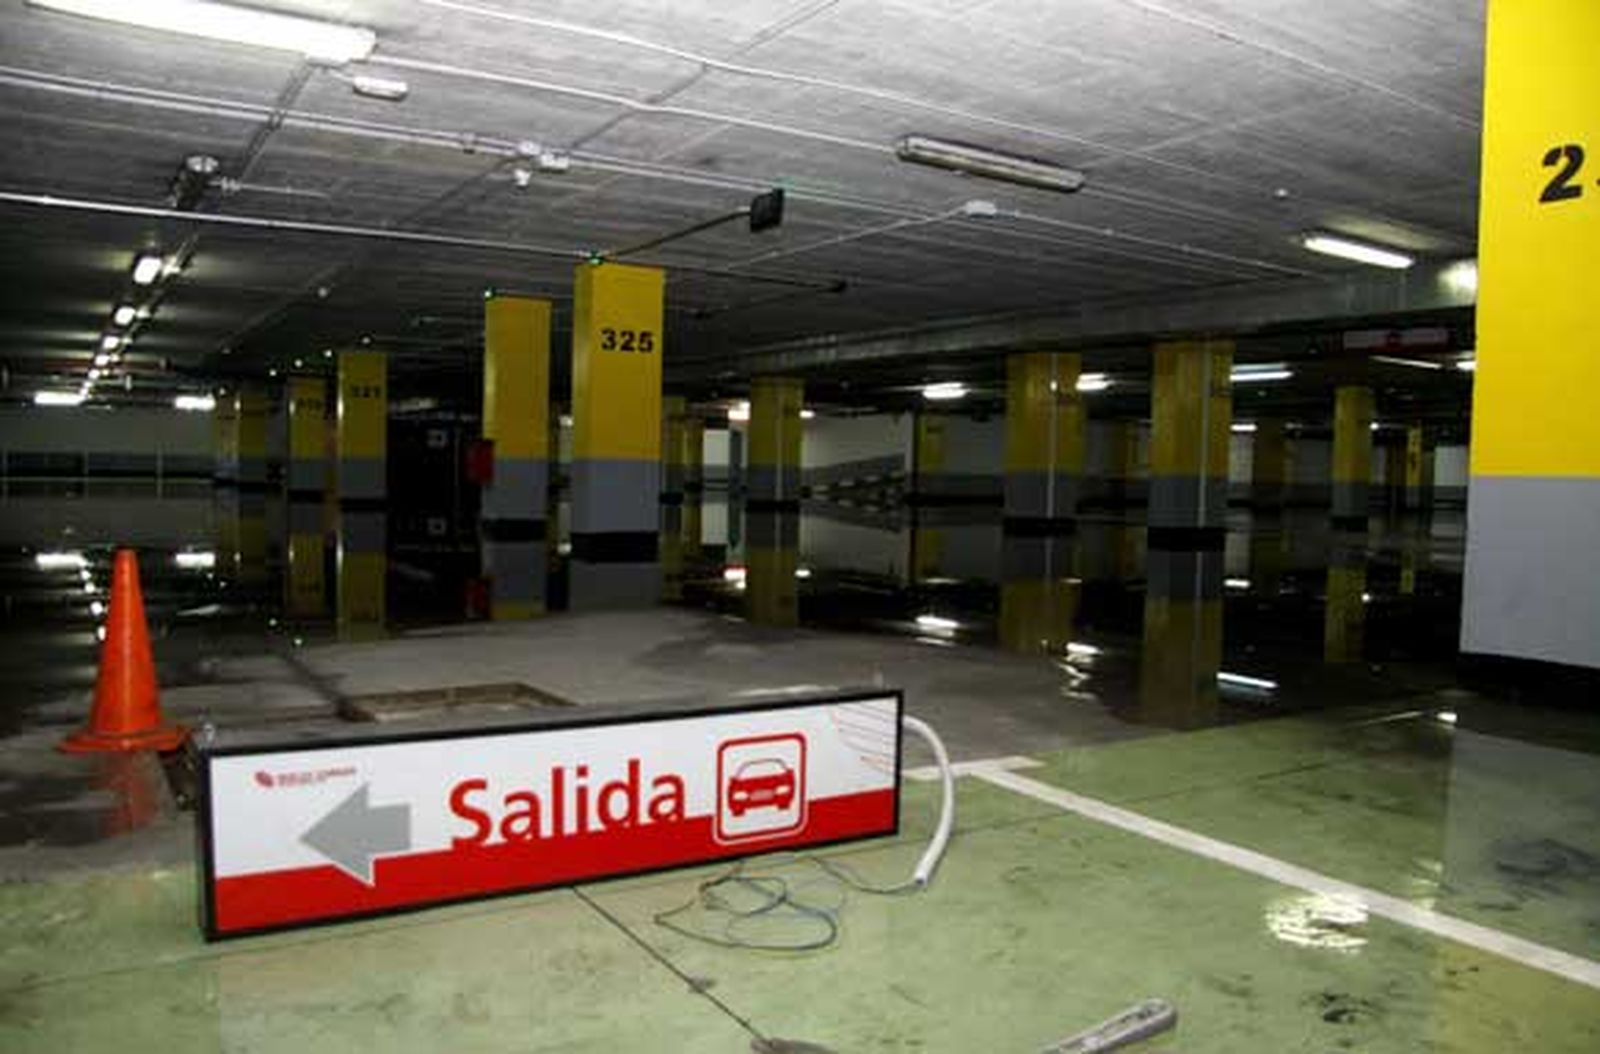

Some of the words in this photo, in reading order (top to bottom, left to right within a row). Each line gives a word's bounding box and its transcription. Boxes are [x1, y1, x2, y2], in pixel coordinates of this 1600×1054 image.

[1539, 144, 1600, 204] 2
[600, 328, 655, 353] 325
[448, 758, 686, 849] Salida
